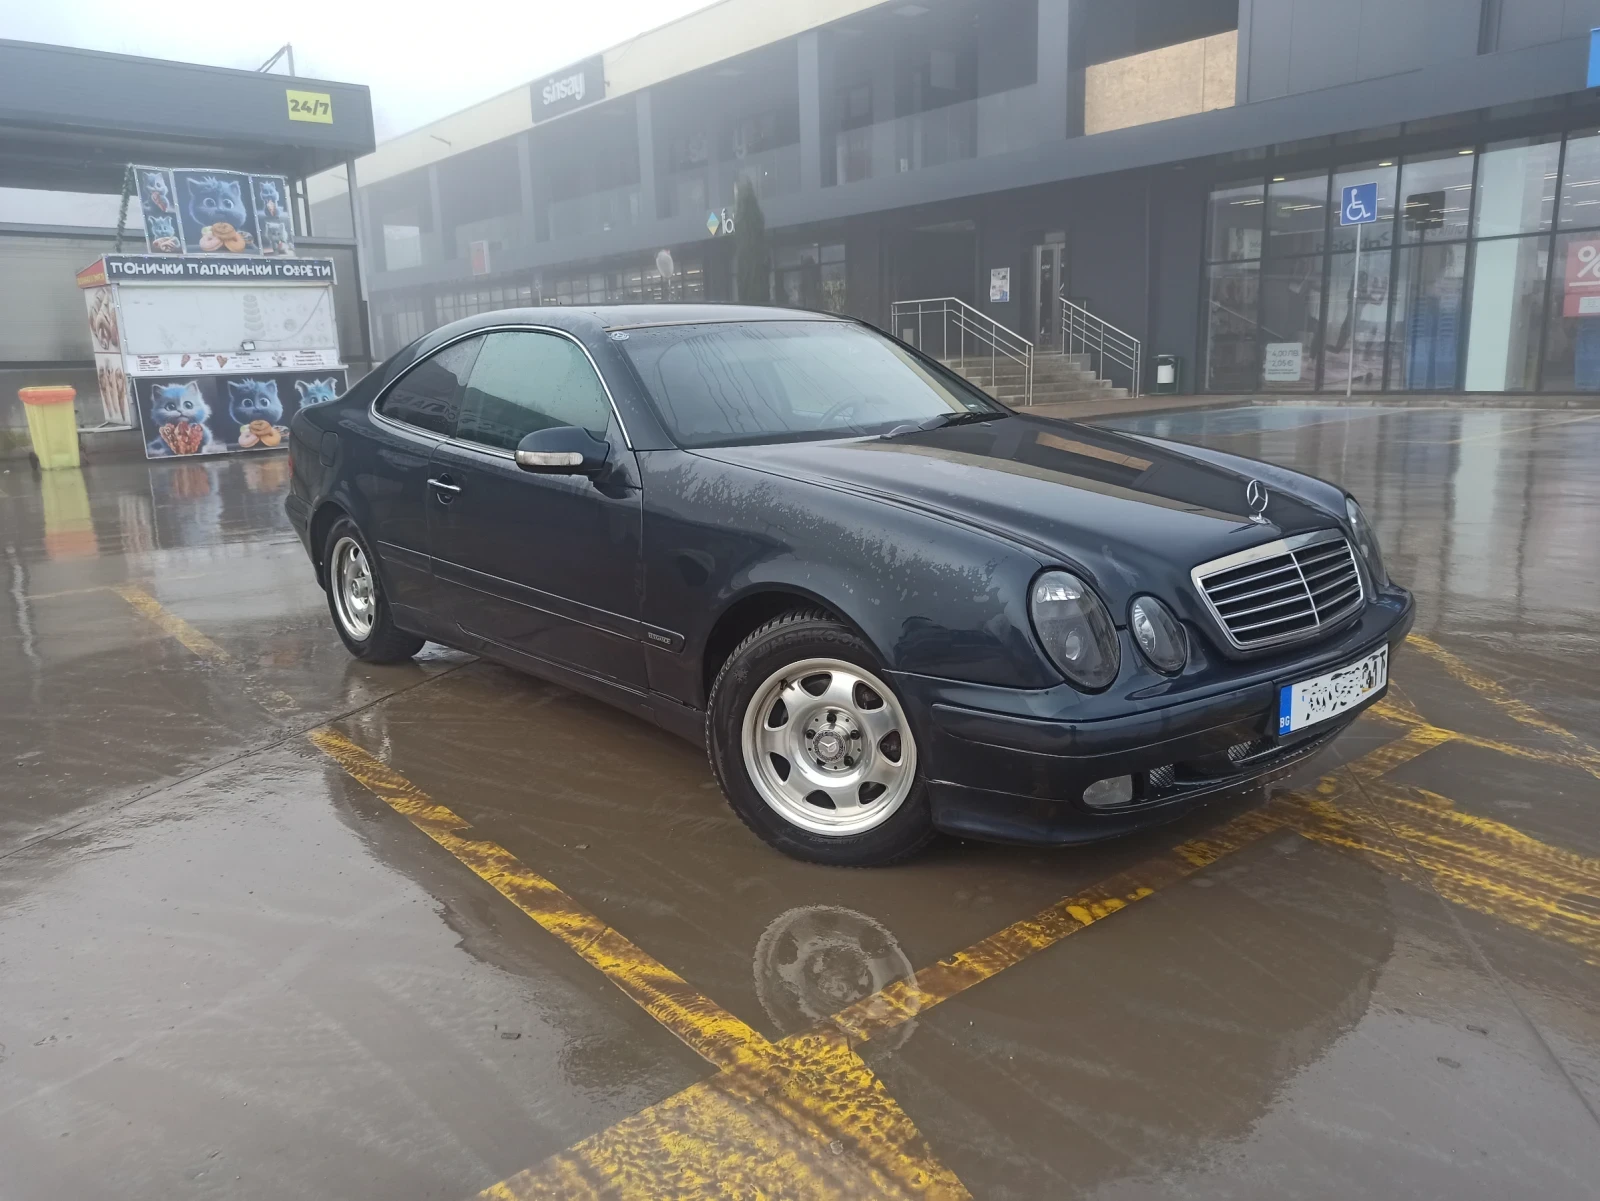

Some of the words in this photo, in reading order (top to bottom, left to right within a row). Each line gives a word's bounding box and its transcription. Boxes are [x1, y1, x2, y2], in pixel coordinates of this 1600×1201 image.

[542, 72, 586, 105] sinsay
[289, 99, 330, 116] 24/7
[110, 261, 184, 275] ПОНИЧКИ
[187, 263, 272, 276] ПАЛАЧИНКИ
[275, 264, 331, 277] ГОФРЕТИ
[1279, 715, 1291, 728] BG
